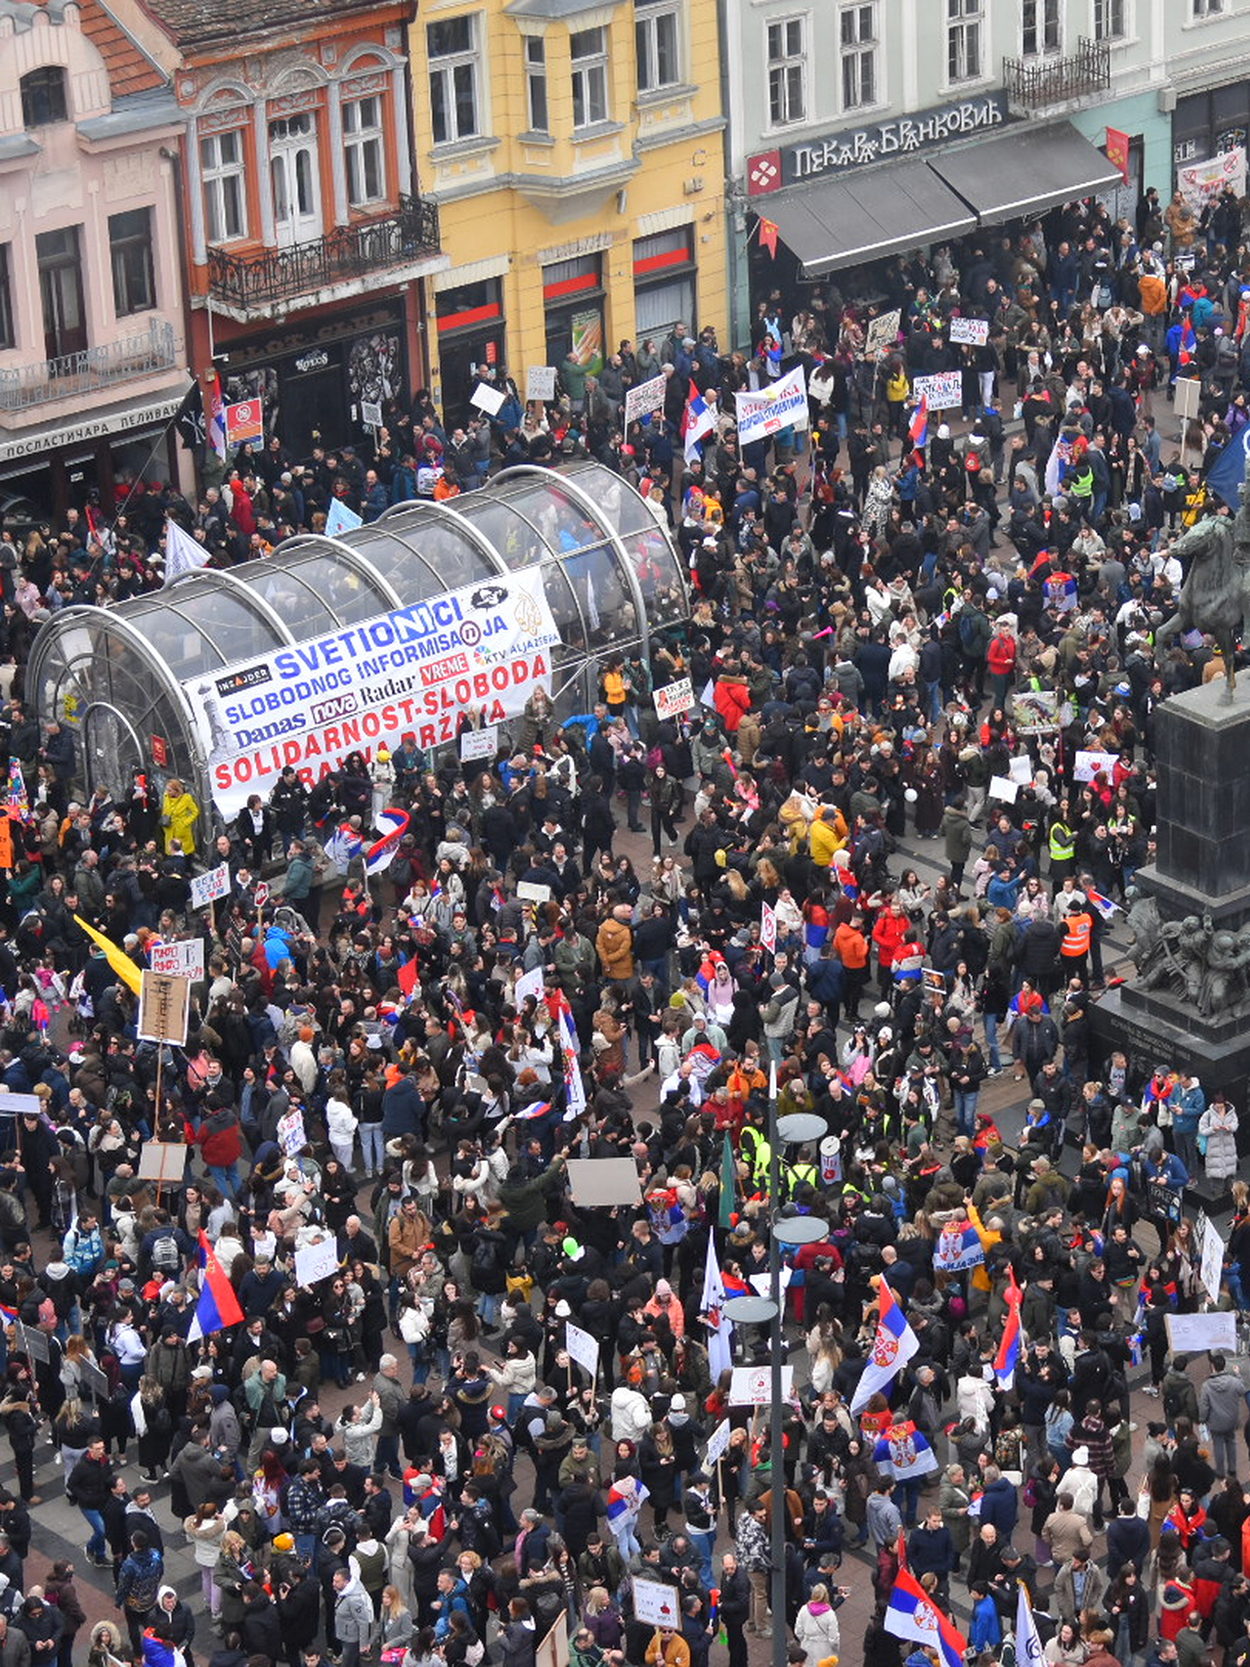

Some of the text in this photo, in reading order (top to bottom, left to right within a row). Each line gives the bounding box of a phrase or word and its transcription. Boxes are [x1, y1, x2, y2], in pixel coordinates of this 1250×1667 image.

[793, 100, 1003, 177] ПЕКАРА БРАНКОВИЋ
[7, 423, 109, 457] ПОСЛАСТИЧАРА
[225, 667, 352, 725] SLOBODNOG
[234, 712, 306, 749] Danas
[312, 694, 357, 725] nova
[360, 675, 416, 706] Radar
[421, 655, 469, 684] VREME
[484, 650, 506, 665] KTV
